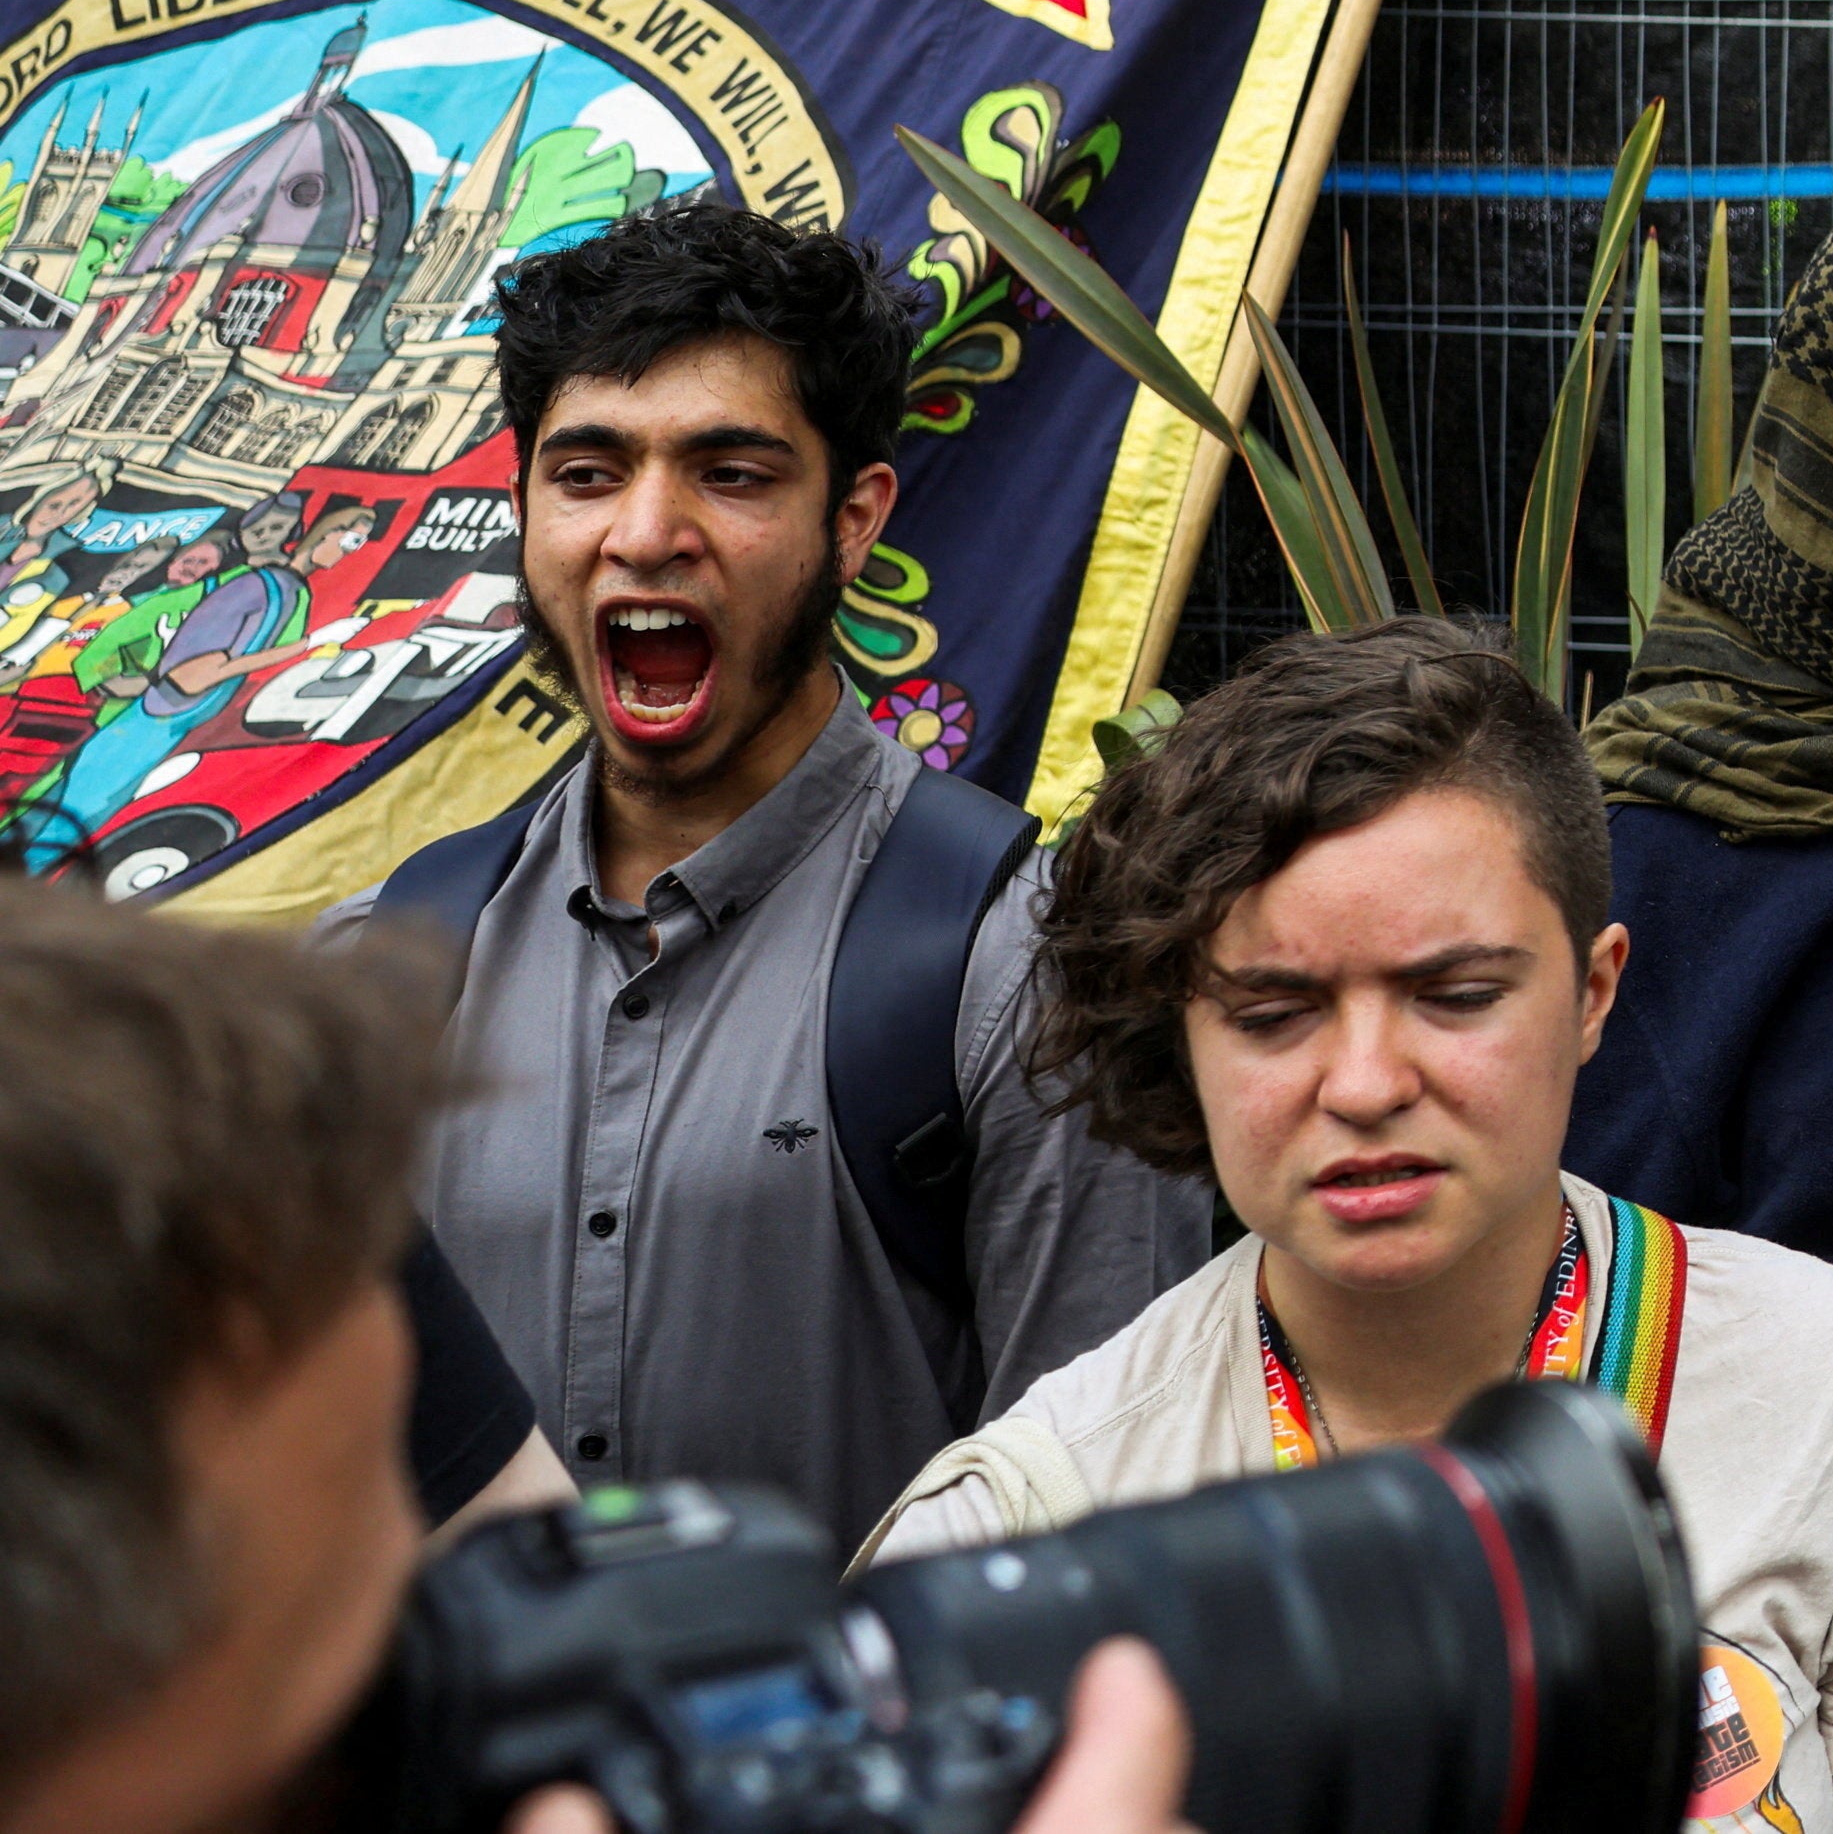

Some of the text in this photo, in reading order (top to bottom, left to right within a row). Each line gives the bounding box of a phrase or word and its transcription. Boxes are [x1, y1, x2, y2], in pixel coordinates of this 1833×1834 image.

[710, 57, 790, 176] WILL,
[406, 525, 504, 553] BUILT
[1552, 1300, 1580, 1329] of
